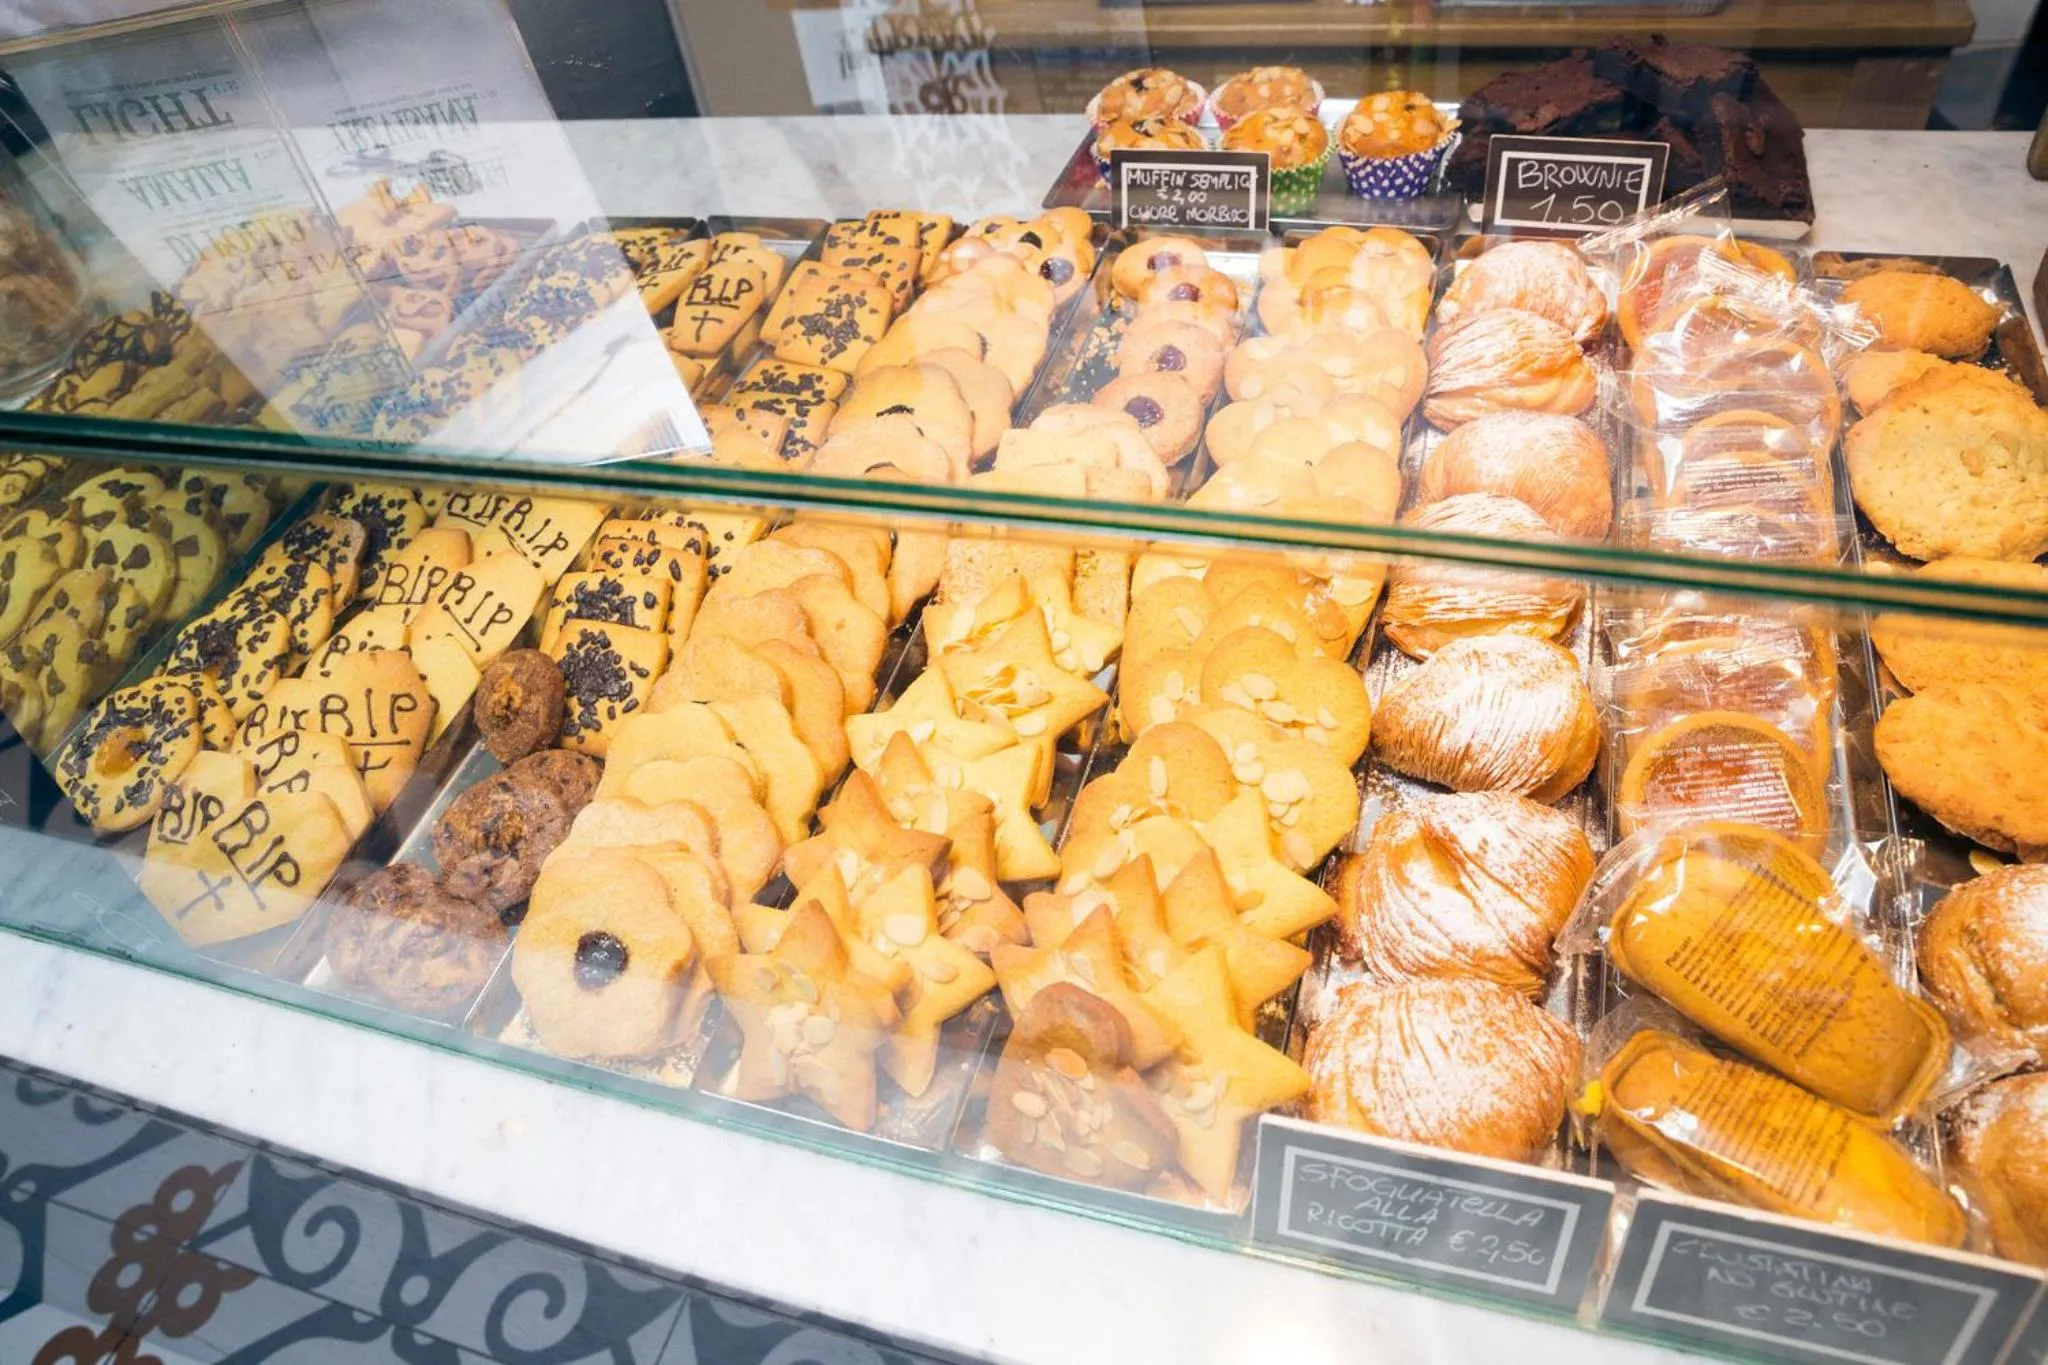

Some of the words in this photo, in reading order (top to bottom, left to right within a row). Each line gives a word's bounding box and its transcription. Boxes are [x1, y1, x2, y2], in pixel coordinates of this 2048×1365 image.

[1126, 168, 1187, 188] MUFFIN
[1518, 160, 1645, 194] BROWNIE
[1530, 193, 1624, 224] 1,50
[687, 274, 753, 304] RIP
[437, 571, 513, 636] RIP
[319, 688, 417, 738] RIP
[212, 800, 300, 889] RIP
[1307, 1202, 1429, 1246] RICOTTA
[1354, 1196, 1439, 1225] ALLA
[1706, 1265, 1756, 1289] NO
